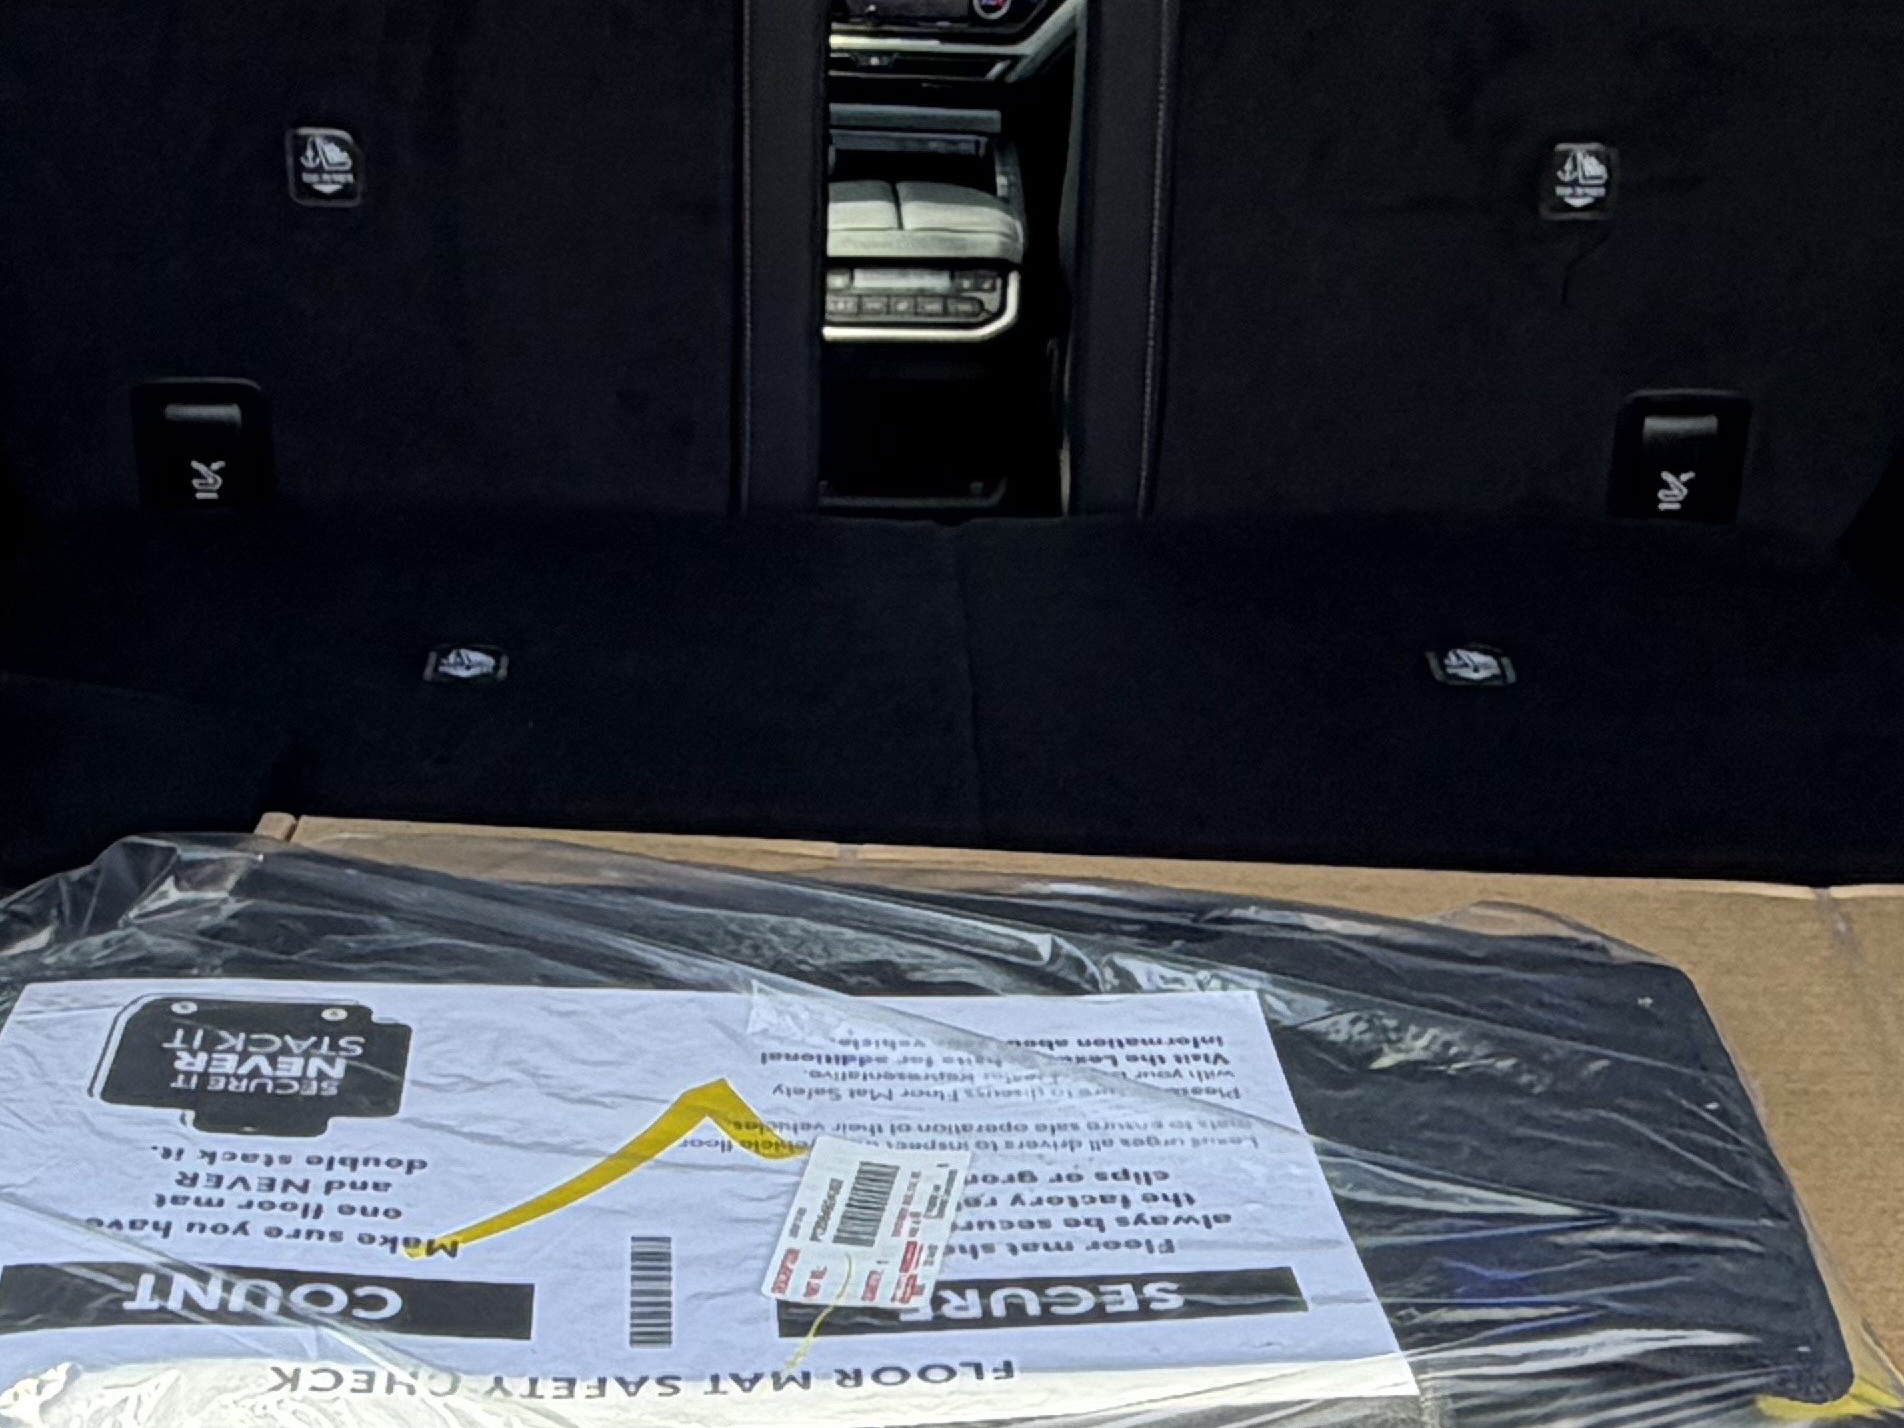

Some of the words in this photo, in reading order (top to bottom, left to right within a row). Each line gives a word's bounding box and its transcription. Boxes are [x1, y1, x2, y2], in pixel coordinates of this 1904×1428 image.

[161, 1028, 205, 1052] IT
[214, 1030, 367, 1057] STACK
[1075, 1036, 1225, 1051] information
[172, 1051, 347, 1081] NEVER
[760, 1052, 888, 1068] additional
[1124, 1053, 1167, 1068] the
[1173, 1052, 1231, 1067] Visit
[169, 1074, 199, 1091] IT
[205, 1074, 341, 1097] SECURE
[772, 1084, 843, 1102] Safety
[848, 1088, 894, 1102] Mat
[833, 1123, 884, 1137] their
[917, 1120, 1030, 1136] operation
[976, 1139, 1000, 1152] to
[1004, 1139, 1083, 1153] drivers
[1089, 1138, 1114, 1152] all
[149, 1145, 185, 1165] it.
[197, 1148, 294, 1168] stack
[304, 1154, 429, 1176] double
[173, 1171, 312, 1195] NEVER
[1049, 1172, 1084, 1183] or
[1095, 1169, 1170, 1186] clips
[322, 1178, 394, 1196] and
[154, 1193, 226, 1209] mat
[1010, 1193, 1132, 1209] factory
[1140, 1192, 1196, 1208] the
[236, 1199, 325, 1220] floor
[336, 1203, 403, 1221] one
[186, 1219, 251, 1240] you
[1063, 1218, 1106, 1233] be
[1115, 1213, 1232, 1230] always
[262, 1225, 345, 1244] sure
[356, 1232, 460, 1259] Make
[1006, 1241, 1074, 1256] mat
[1084, 1238, 1176, 1254] Floor
[123, 1273, 403, 1321] COUNT
[269, 1366, 460, 1397] CHECK
[703, 1371, 812, 1395] MAT
[833, 1361, 1015, 1388] FLOOR
[486, 1375, 684, 1400] SAFETY
